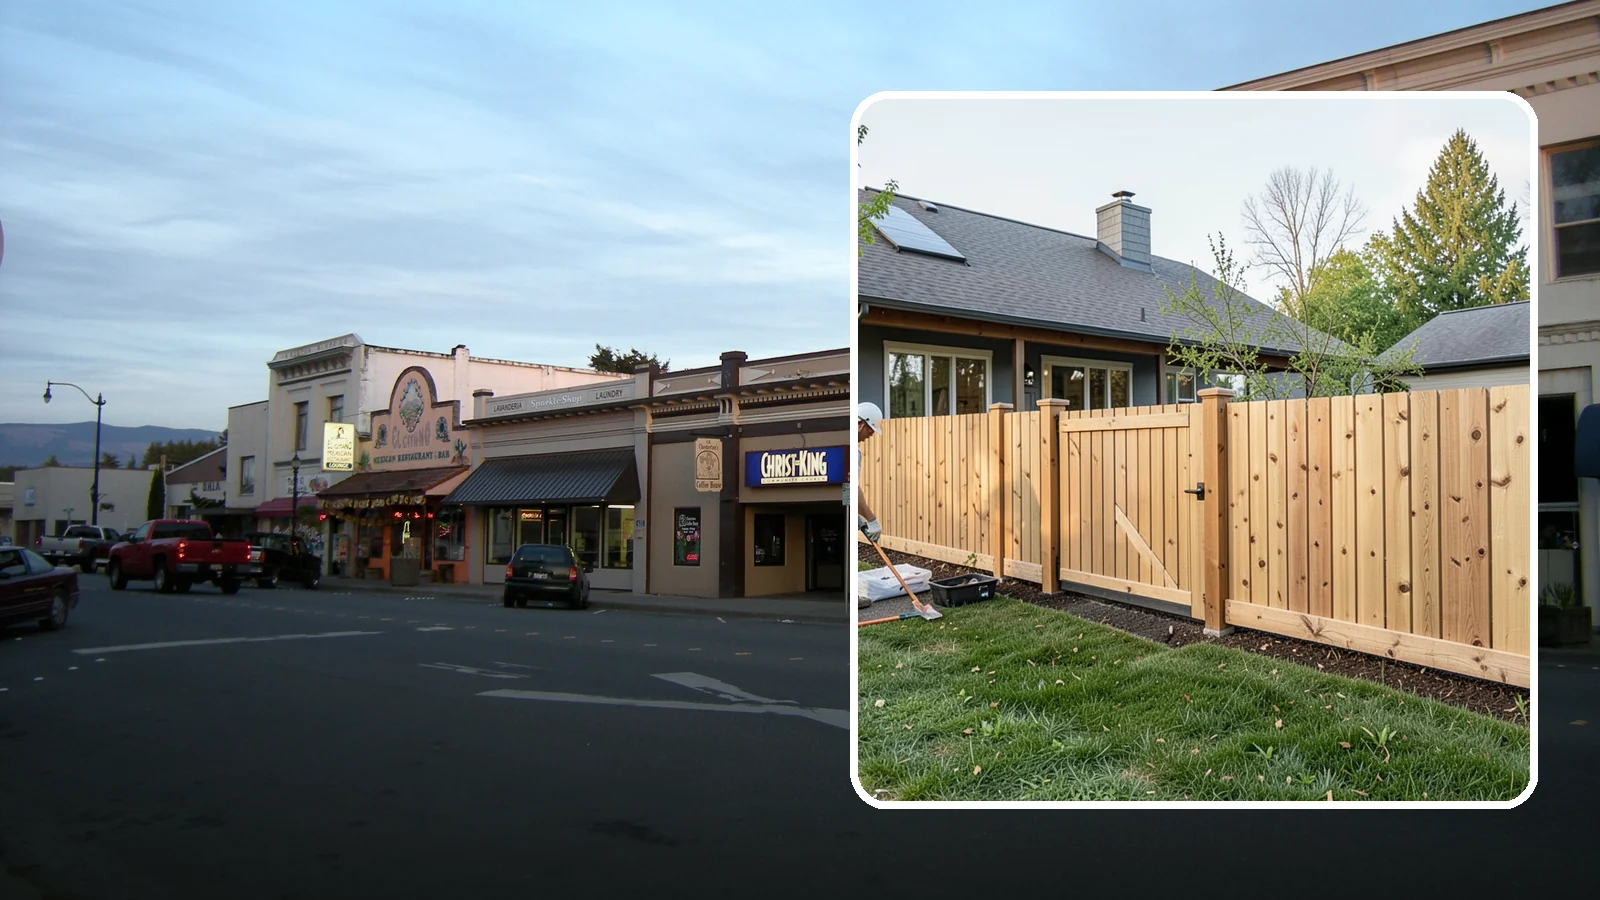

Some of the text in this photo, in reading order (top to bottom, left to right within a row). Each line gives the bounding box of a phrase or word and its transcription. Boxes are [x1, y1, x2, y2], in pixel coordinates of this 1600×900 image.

[493, 402, 523, 413] LAVANDERIA
[595, 389, 624, 400] LAUNDRY
[373, 455, 397, 464] MEXICAN
[397, 451, 434, 462] RESTAURANT
[437, 450, 450, 459] BAR
[799, 450, 827, 476] KING
[696, 480, 722, 489] Coffee House
